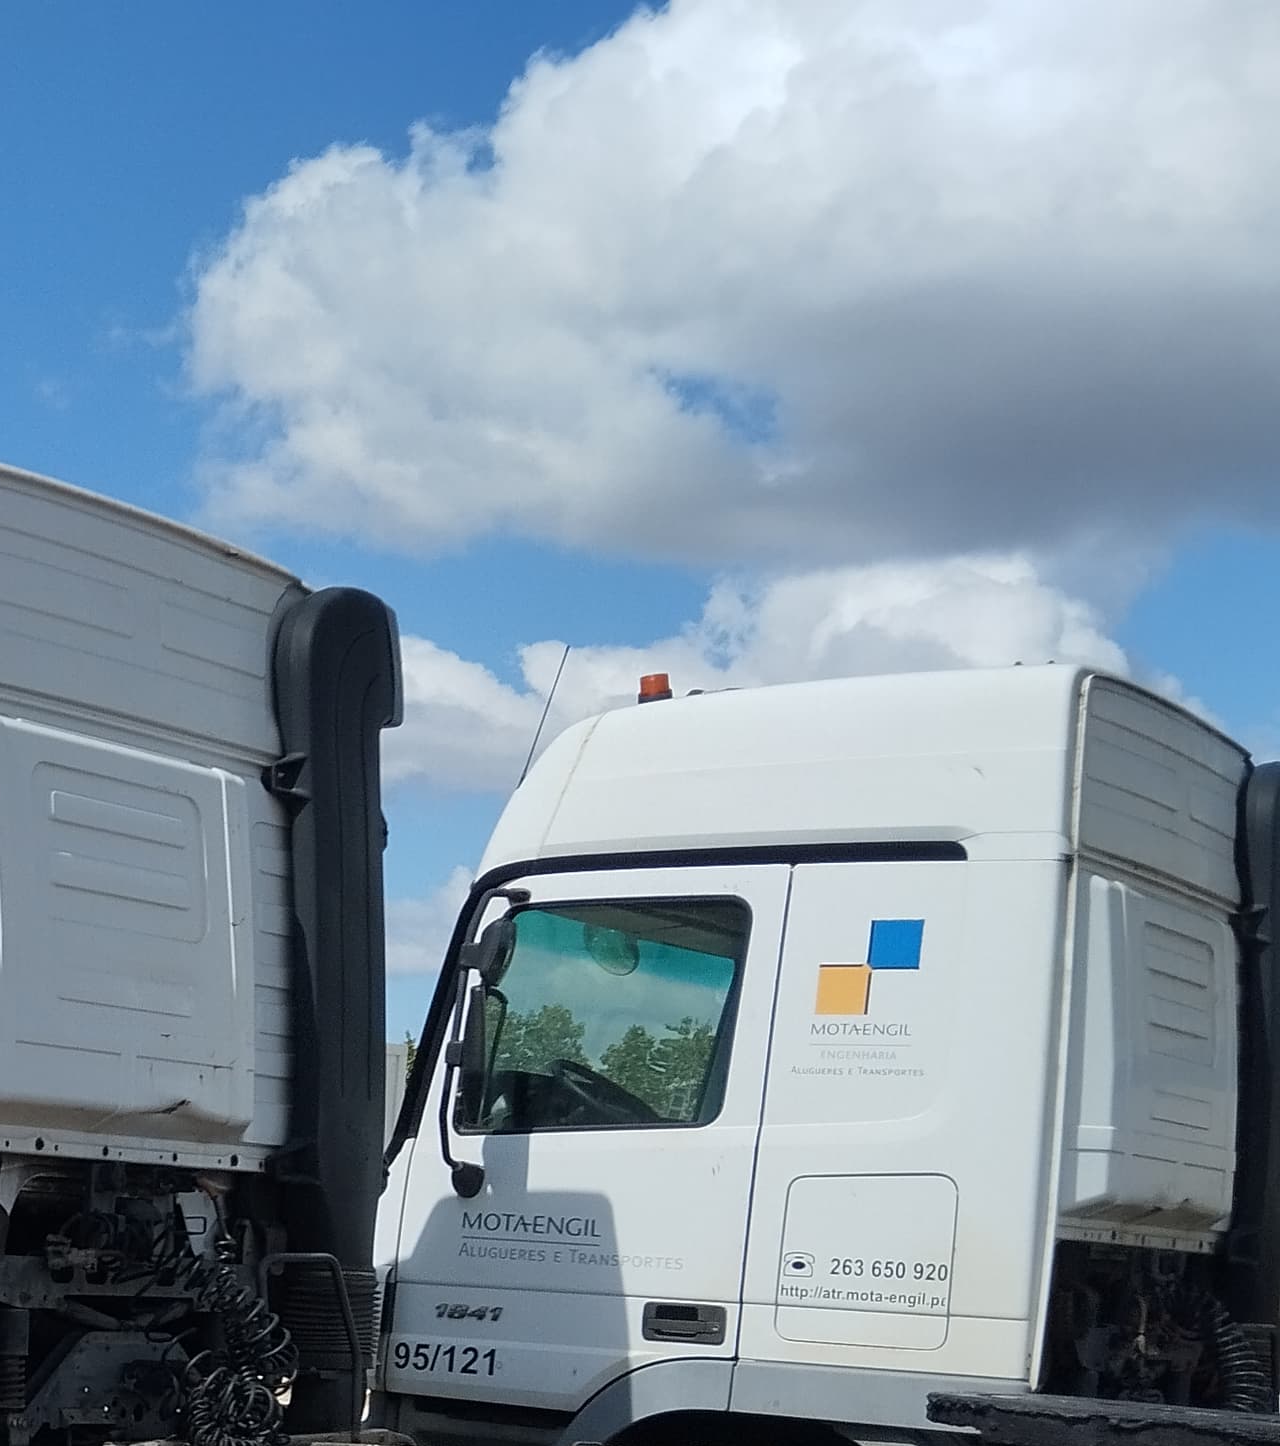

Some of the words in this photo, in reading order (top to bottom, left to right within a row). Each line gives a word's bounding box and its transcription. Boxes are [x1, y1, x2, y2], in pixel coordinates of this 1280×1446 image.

[820, 1049, 897, 1061] ENGENHARIA
[829, 1258, 864, 1277] 263
[871, 1260, 906, 1279] 650
[913, 1262, 948, 1282] 920
[435, 1303, 504, 1322] 1841
[394, 1341, 497, 1376] 95/121
